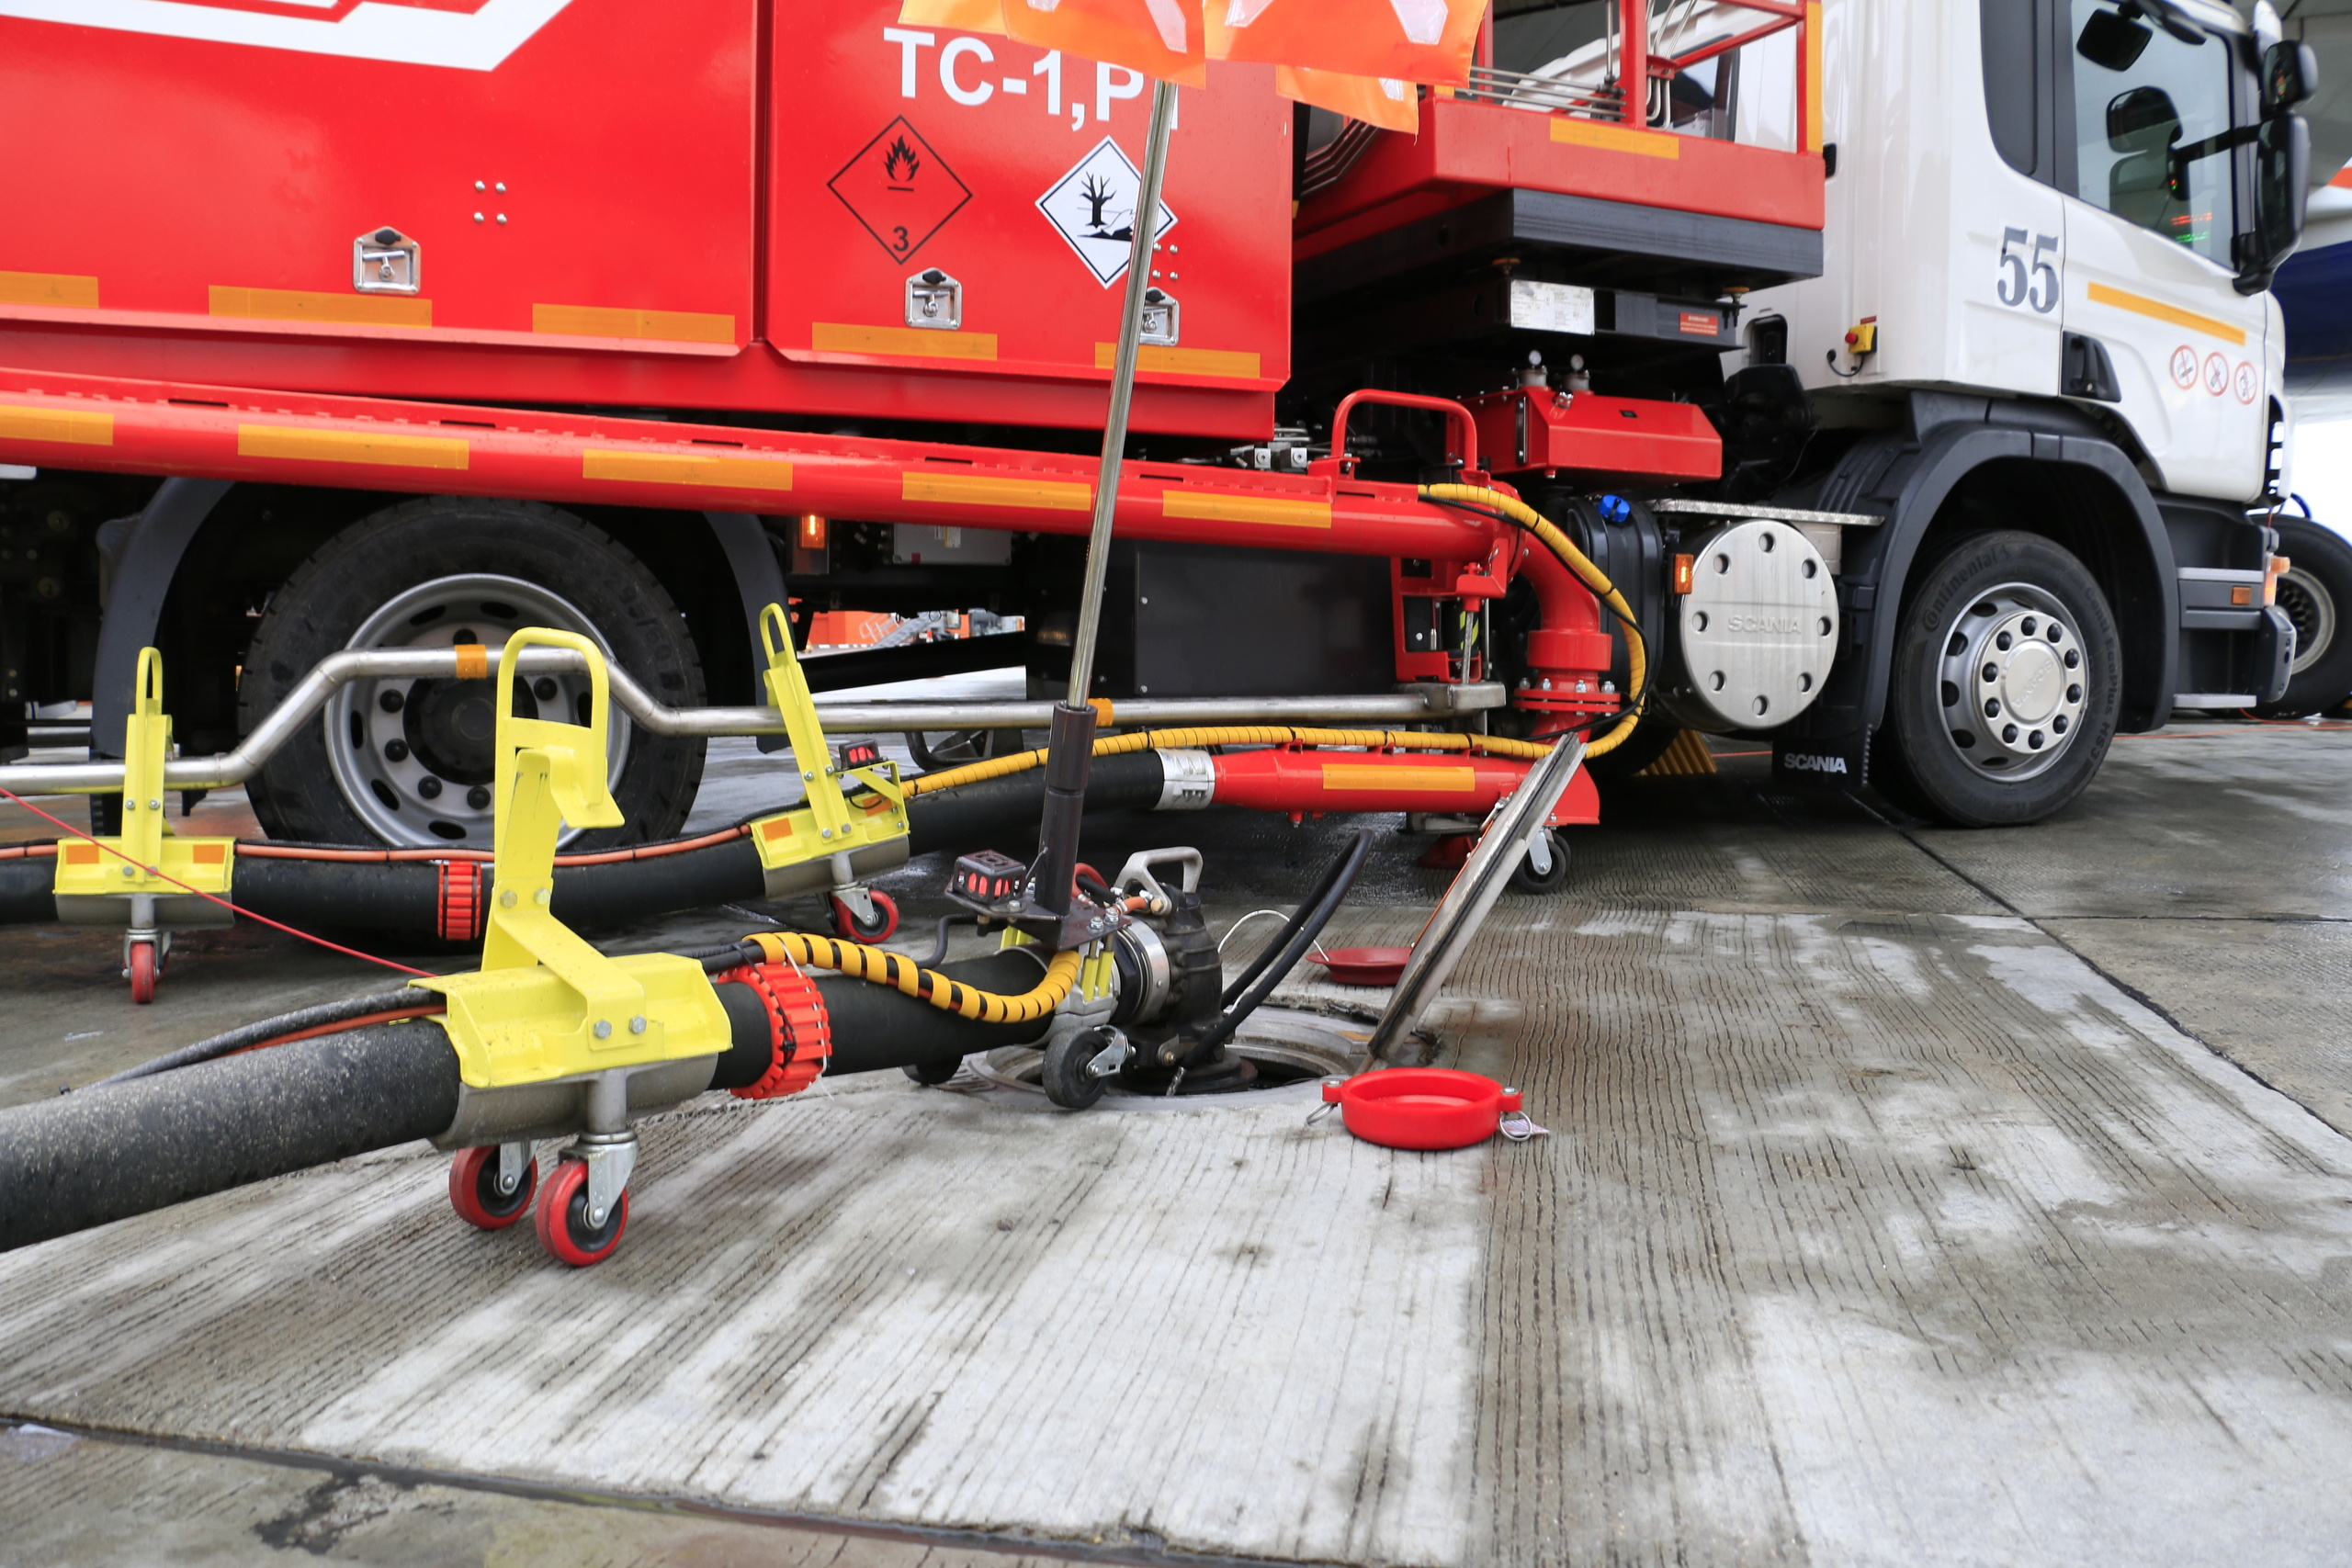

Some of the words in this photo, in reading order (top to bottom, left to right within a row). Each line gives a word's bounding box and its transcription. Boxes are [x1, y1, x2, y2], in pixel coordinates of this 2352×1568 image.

[883, 27, 1179, 131] ТС-1,Р
[892, 226, 910, 252] 3
[1996, 225, 2060, 314] 55
[1922, 547, 1999, 633] Continental
[1728, 614, 1801, 636] SCANIA
[1784, 753, 1847, 774] SCANIA
